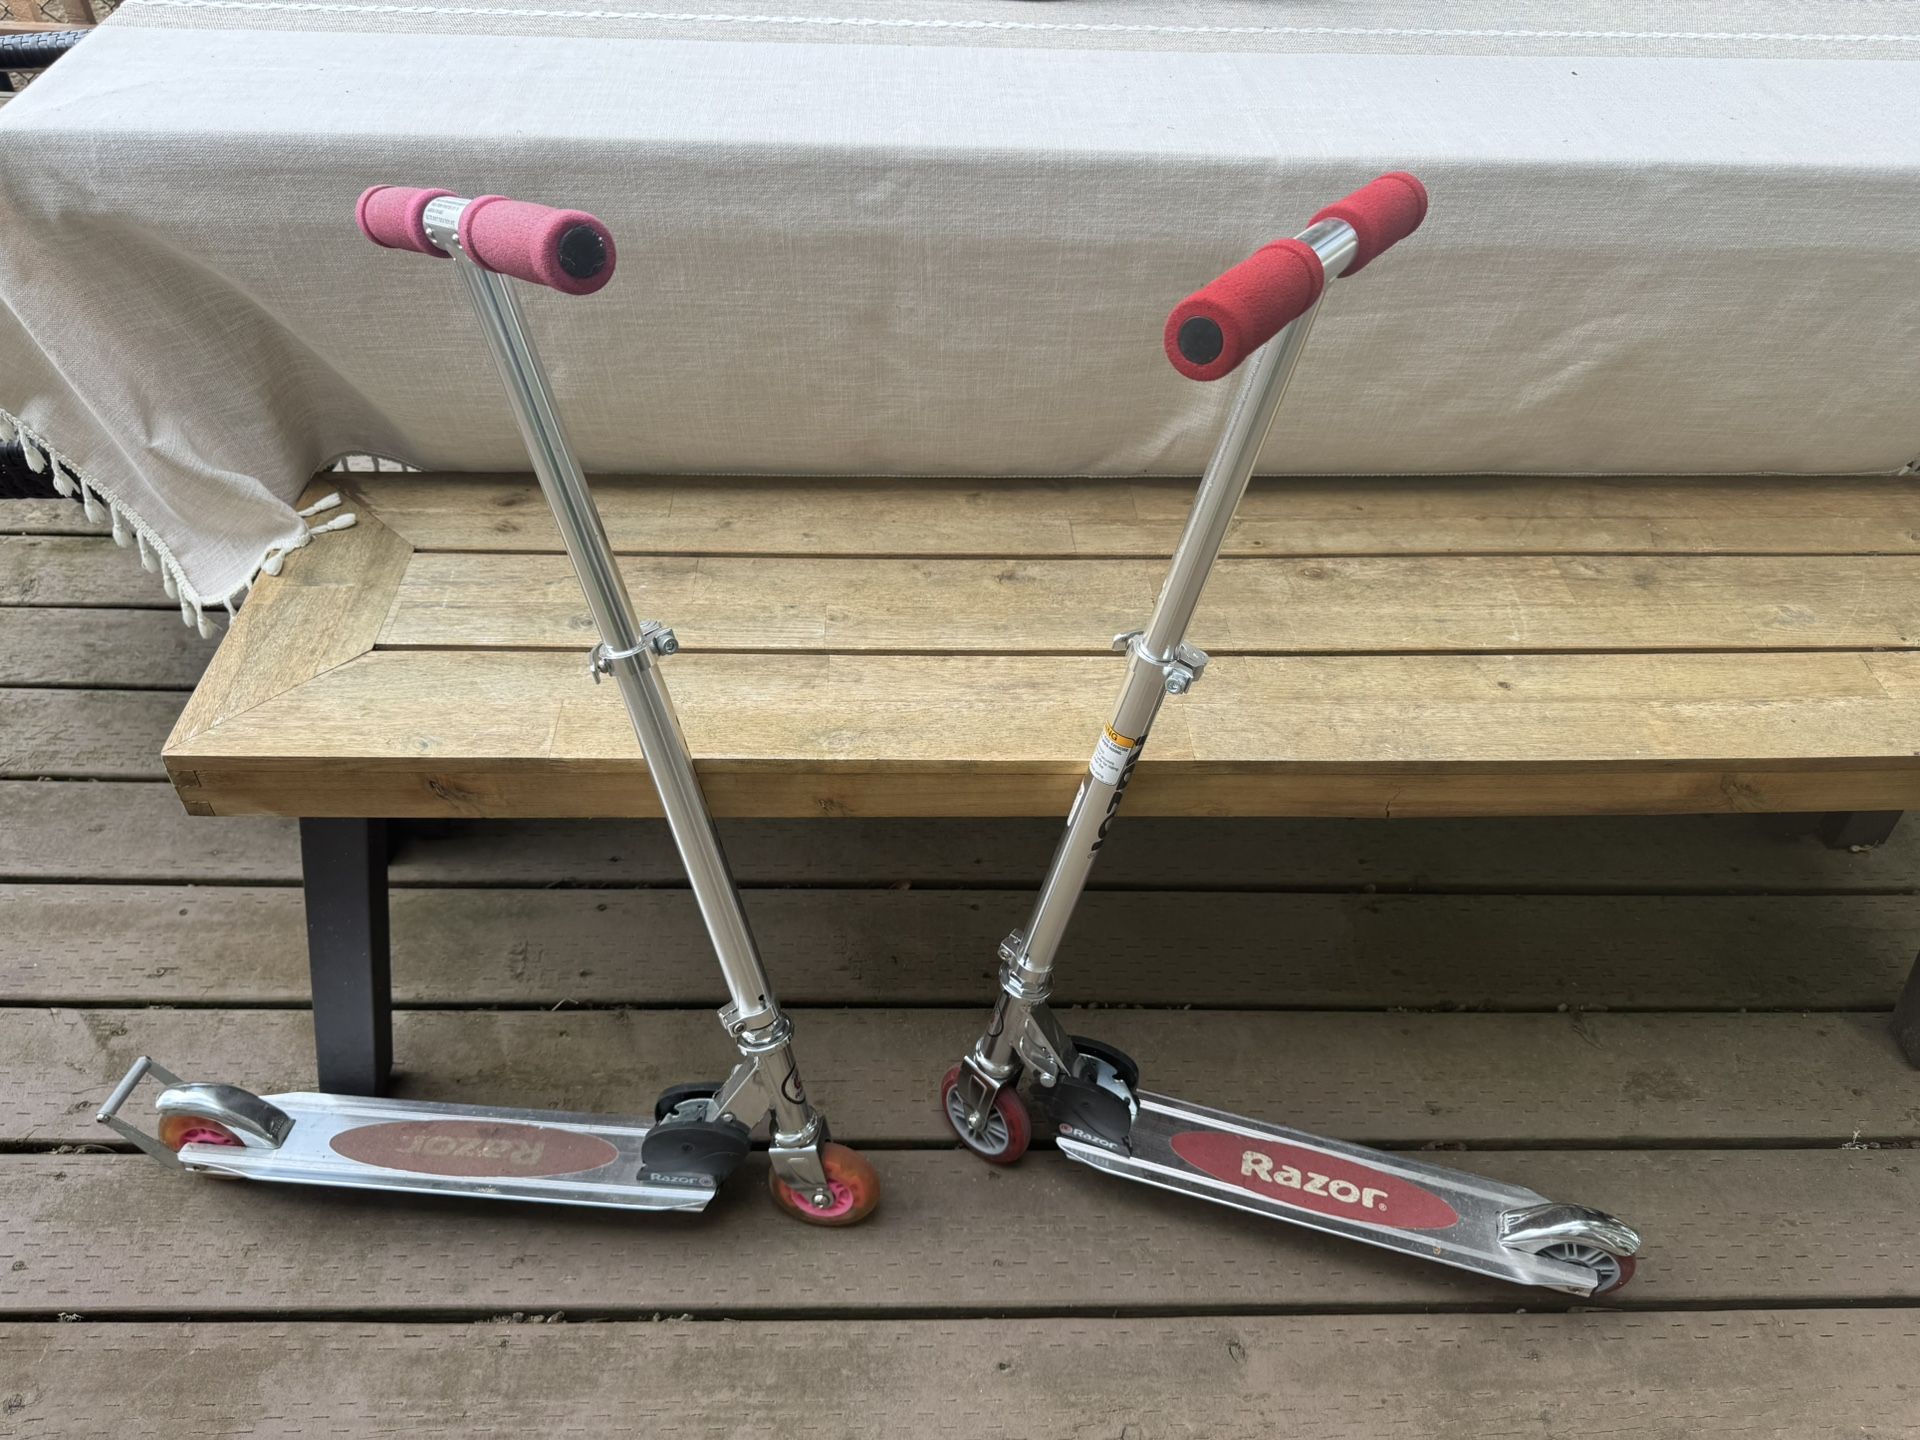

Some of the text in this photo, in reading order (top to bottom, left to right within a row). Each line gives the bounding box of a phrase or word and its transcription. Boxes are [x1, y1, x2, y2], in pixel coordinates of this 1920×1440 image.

[1073, 1128, 1118, 1150] Razor
[396, 1135, 545, 1166] Razor
[650, 1172, 698, 1184] Razor
